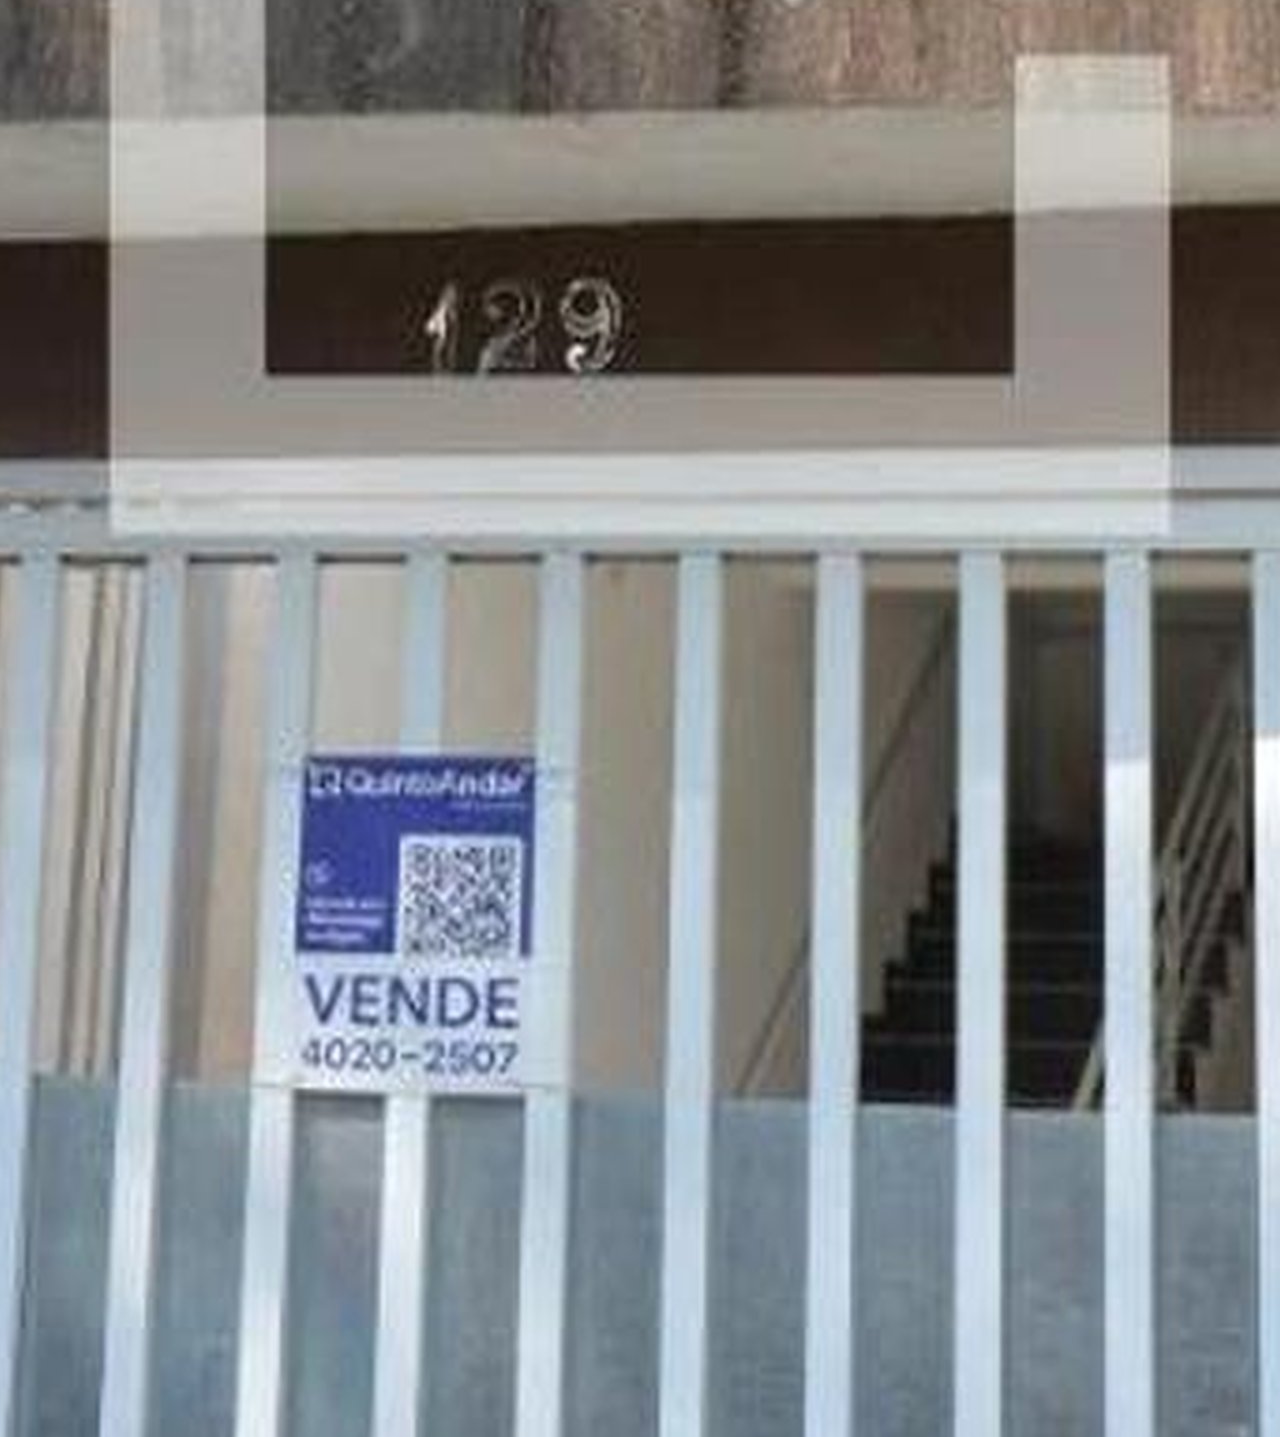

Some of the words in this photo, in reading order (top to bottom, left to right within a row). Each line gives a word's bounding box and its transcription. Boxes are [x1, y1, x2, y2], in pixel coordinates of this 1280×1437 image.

[423, 280, 622, 375] 129
[303, 974, 520, 1029] VENDE
[302, 1037, 518, 1074] 4020-2507
